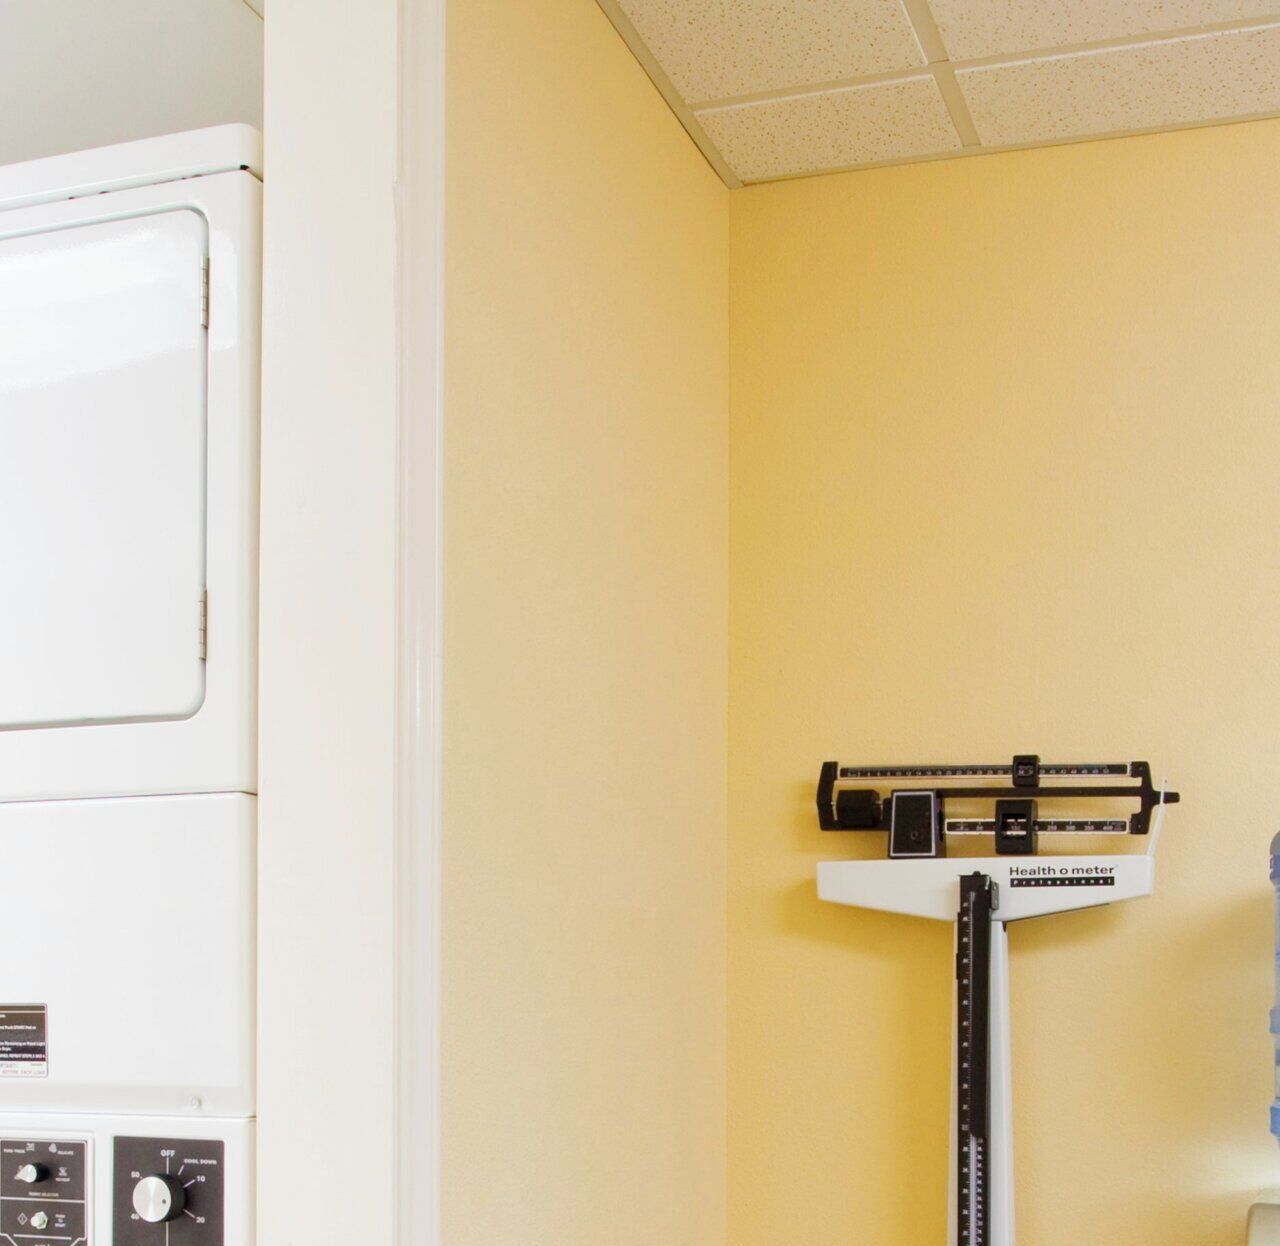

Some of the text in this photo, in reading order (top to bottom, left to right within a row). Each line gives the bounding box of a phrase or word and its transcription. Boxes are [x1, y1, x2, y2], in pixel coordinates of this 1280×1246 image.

[1009, 865, 1114, 876] Health o meter
